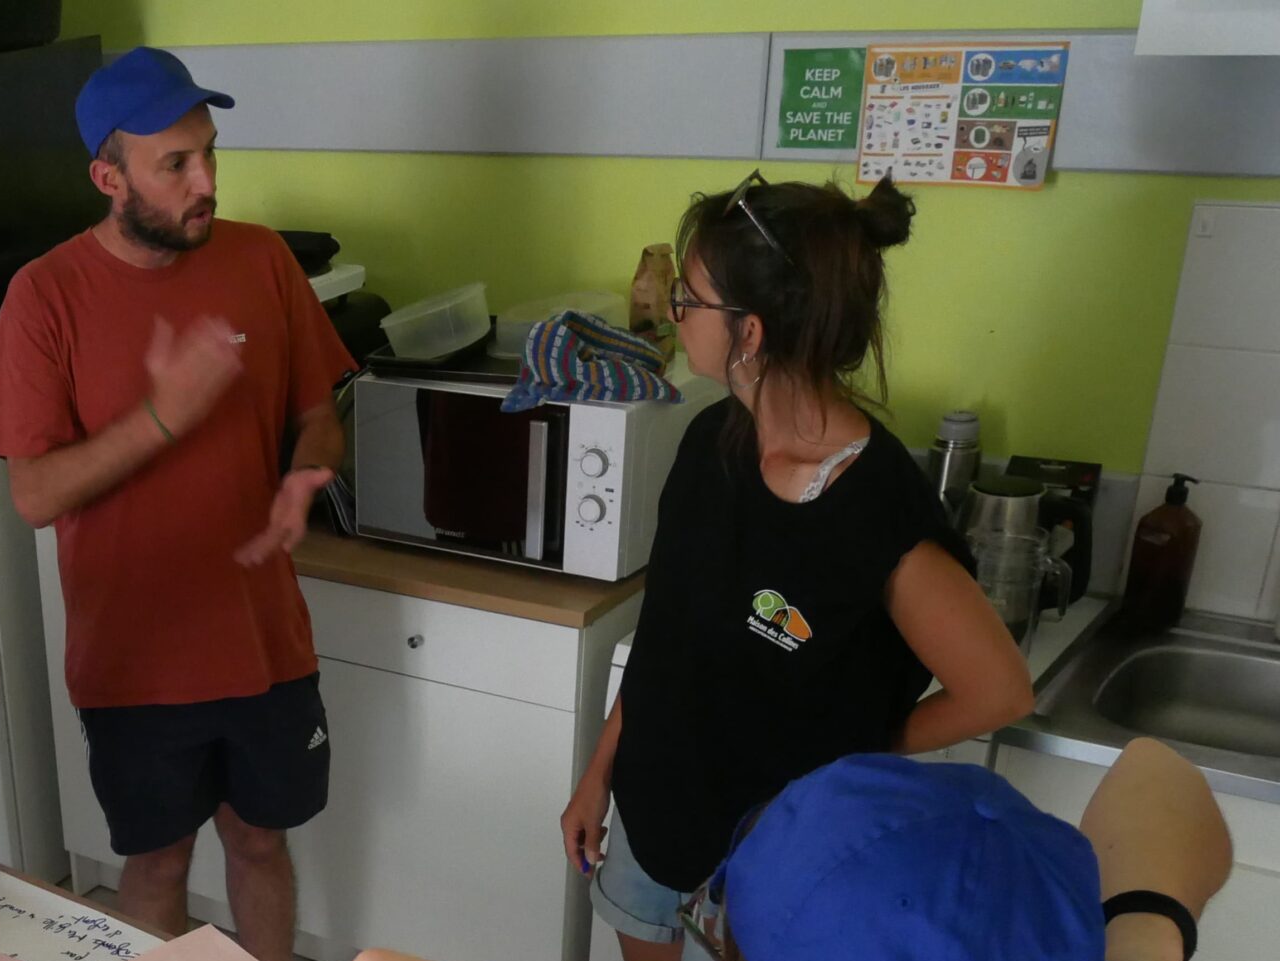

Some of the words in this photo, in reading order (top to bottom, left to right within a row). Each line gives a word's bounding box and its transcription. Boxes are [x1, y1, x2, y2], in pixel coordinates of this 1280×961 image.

[805, 69, 841, 81] KEEP
[800, 86, 842, 99] CALM
[786, 111, 821, 124] SAVE
[825, 112, 852, 125] THE
[790, 128, 845, 141] PLANET
